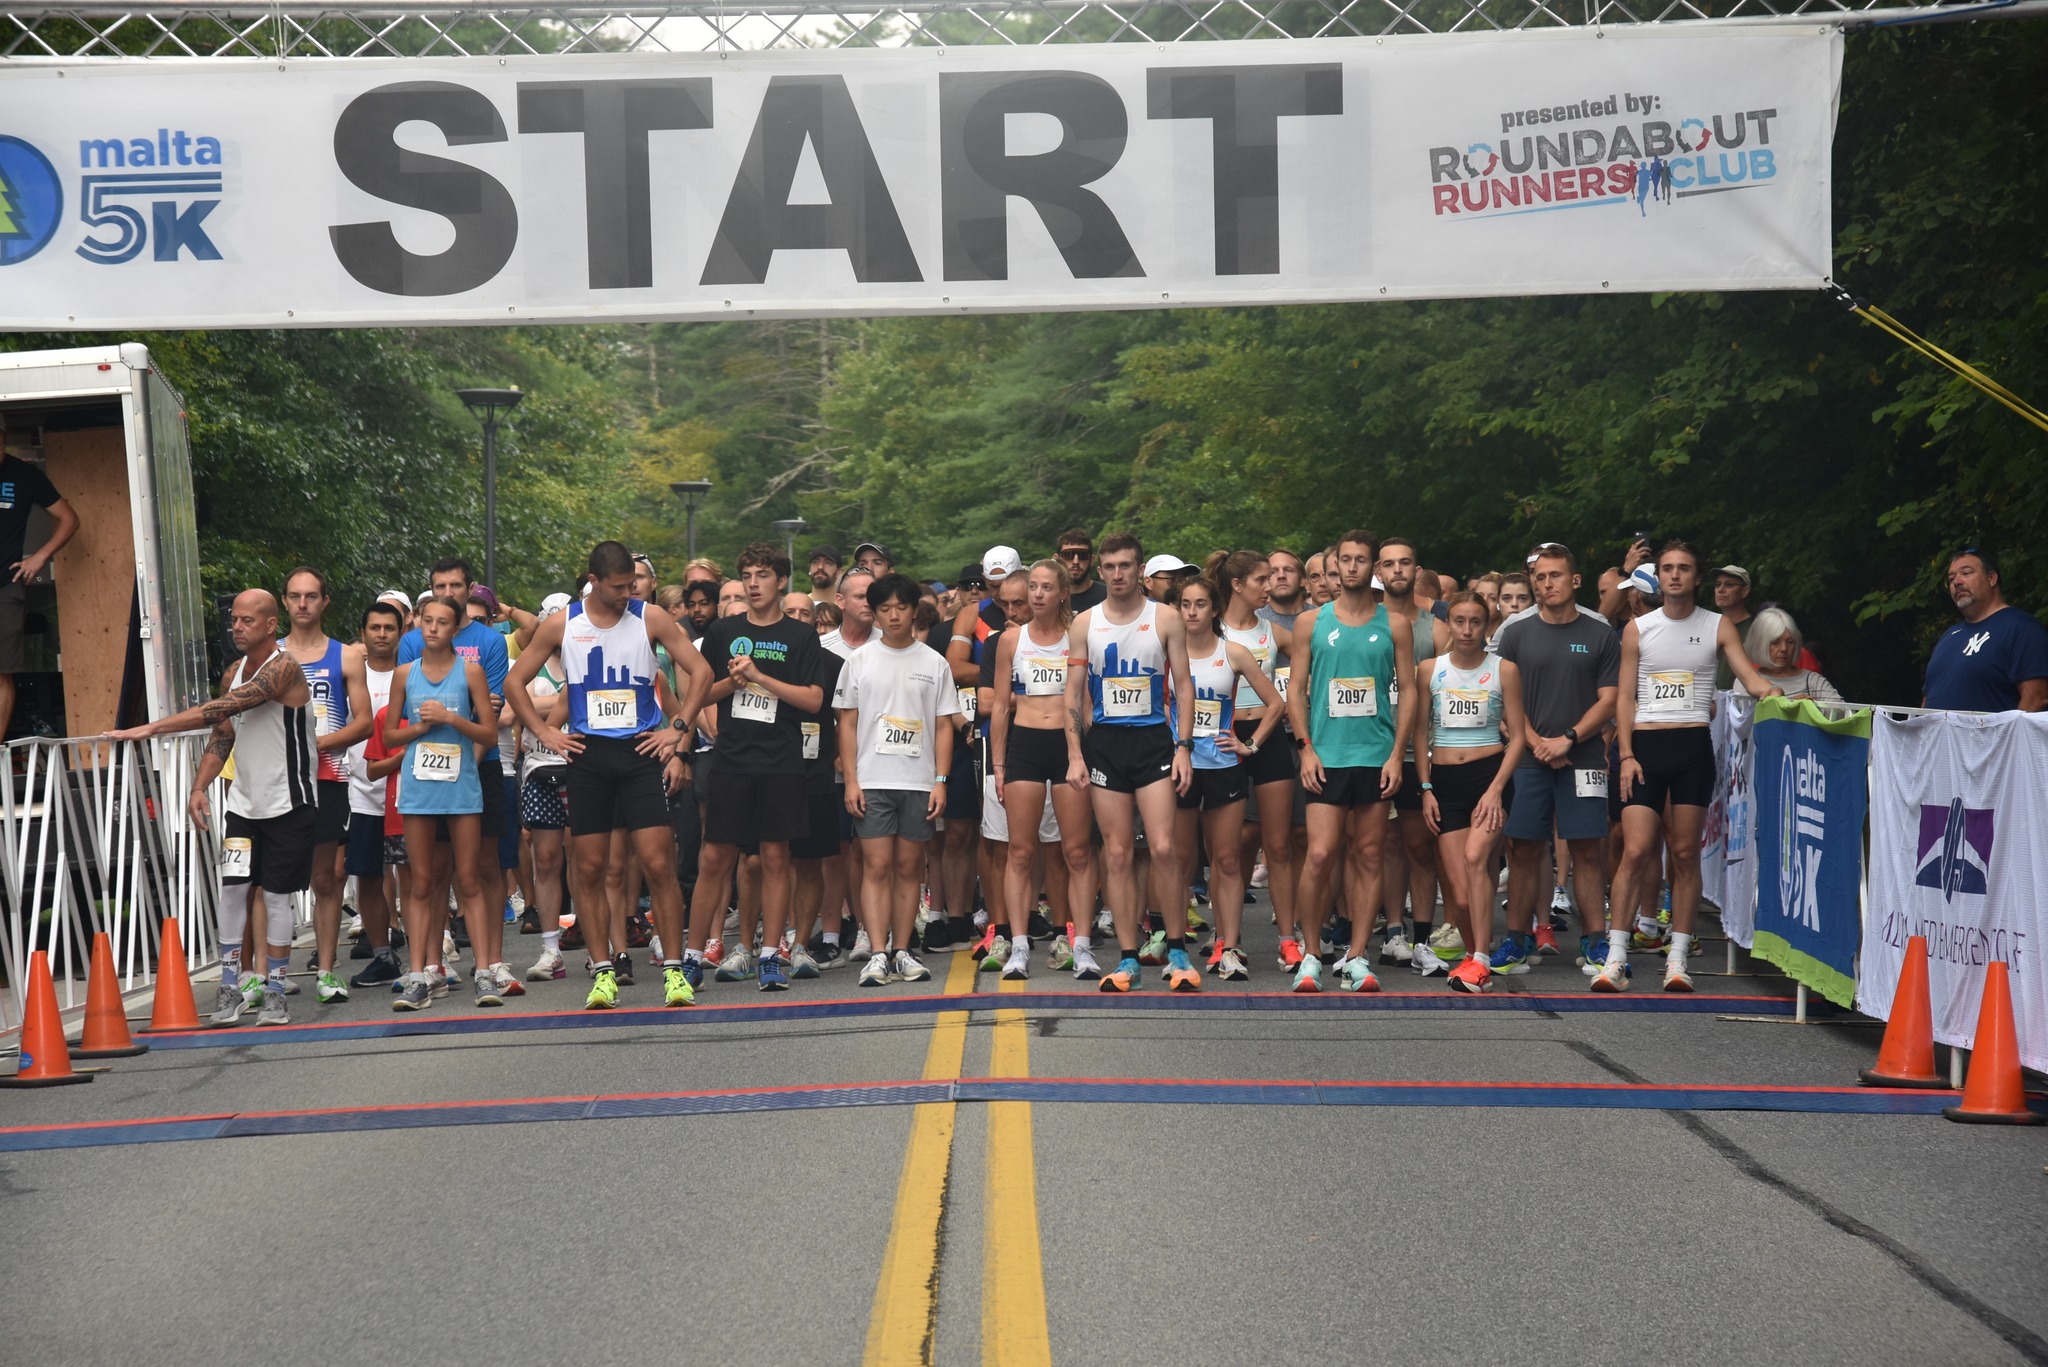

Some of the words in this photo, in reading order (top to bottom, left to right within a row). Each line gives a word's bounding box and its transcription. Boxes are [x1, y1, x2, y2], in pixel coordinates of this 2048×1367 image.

[1501, 94, 1618, 133] presented
[1624, 92, 1661, 115] by:
[79, 128, 222, 168] malta
[1429, 108, 1777, 183] ROUNDABOUT
[328, 62, 1344, 296] START
[1433, 163, 1635, 215] RUNNERS
[1667, 149, 1777, 188] CLUB
[75, 171, 224, 265] 5K
[755, 641, 788, 652] malta
[1570, 644, 1589, 653] TEL
[1033, 669, 1062, 683] 2075
[1112, 689, 1142, 704] 1977
[1337, 689, 1367, 704] 2097
[1655, 684, 1685, 699] 2226
[740, 692, 770, 710] 1706
[1449, 700, 1479, 715] 2095
[597, 702, 627, 717] 1607
[886, 729, 915, 744] 2047
[422, 754, 451, 769] 2221
